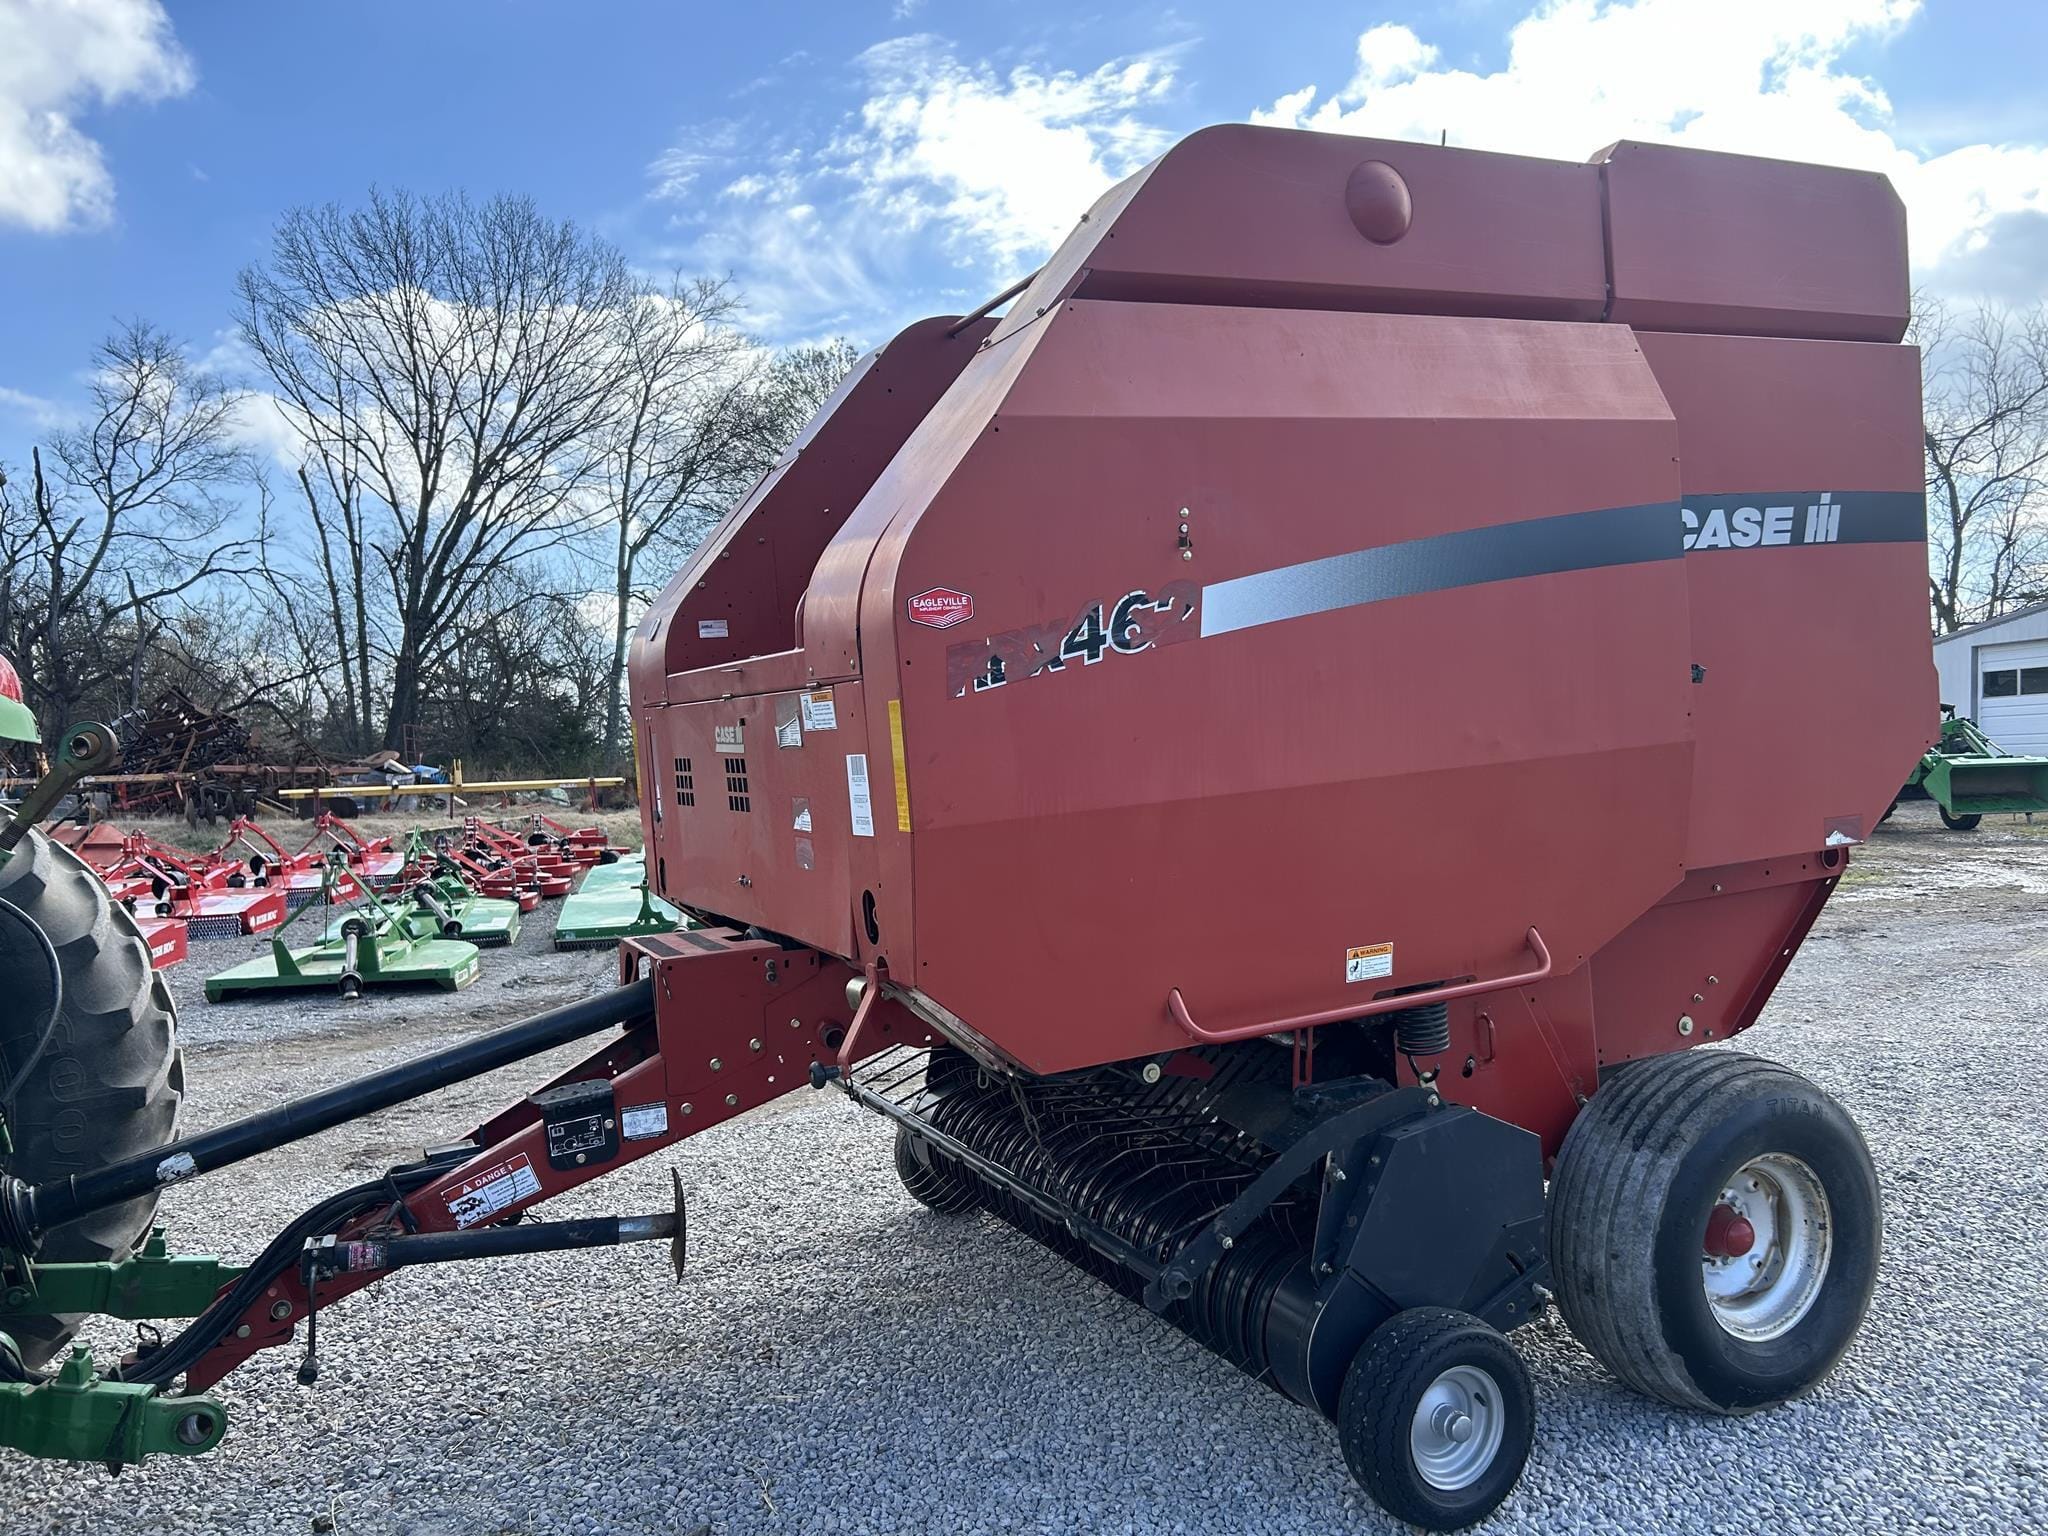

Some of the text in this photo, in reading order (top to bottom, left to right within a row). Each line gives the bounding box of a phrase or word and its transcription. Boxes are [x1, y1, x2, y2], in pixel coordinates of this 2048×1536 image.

[1681, 506, 1795, 551] CASE
[913, 596, 968, 608] EAGLEVILLE
[715, 726, 735, 744] CASE
[1360, 946, 1388, 956] WARNING
[1766, 1097, 1824, 1121] TITAN
